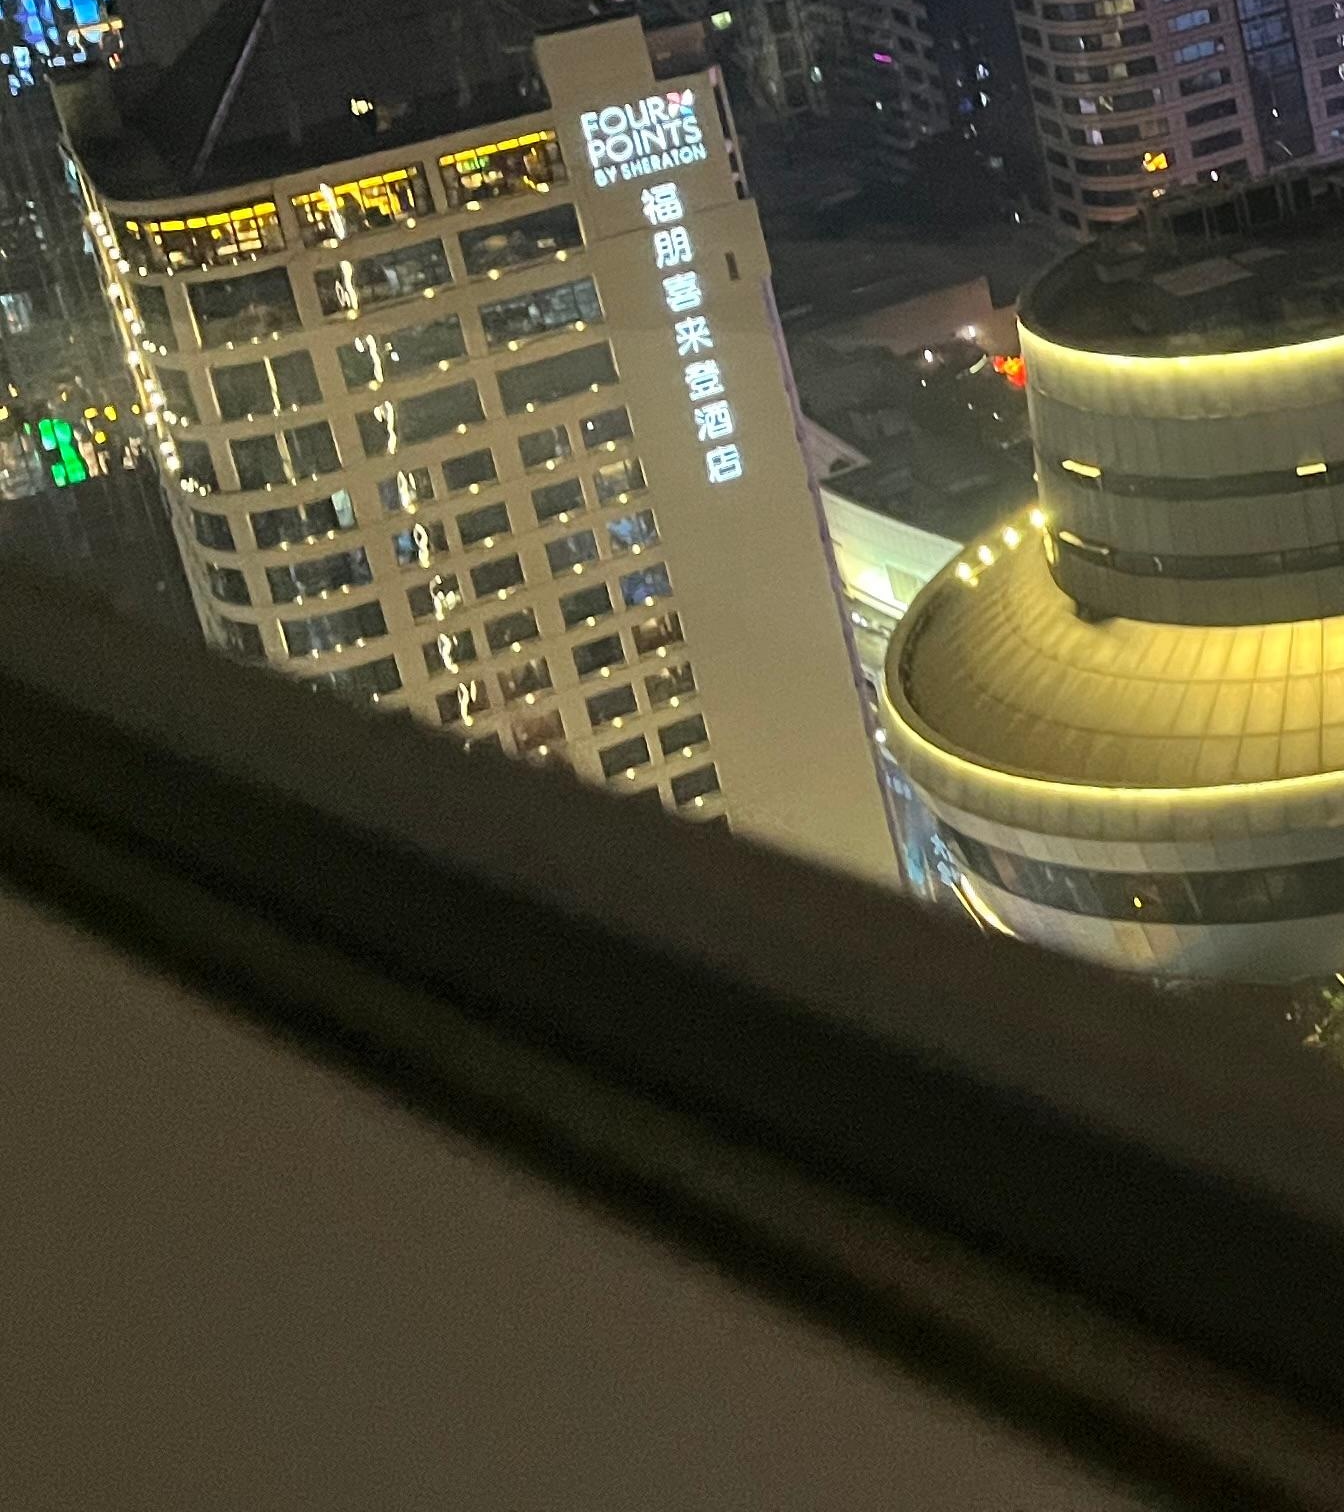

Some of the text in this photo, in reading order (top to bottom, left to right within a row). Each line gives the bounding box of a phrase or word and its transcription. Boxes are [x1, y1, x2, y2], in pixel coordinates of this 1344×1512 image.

[581, 96, 670, 141] FOUR
[588, 116, 703, 169] POINTS
[594, 143, 707, 187] BY SHERATON
[641, 182, 743, 483] 福朋喜来登酒店
